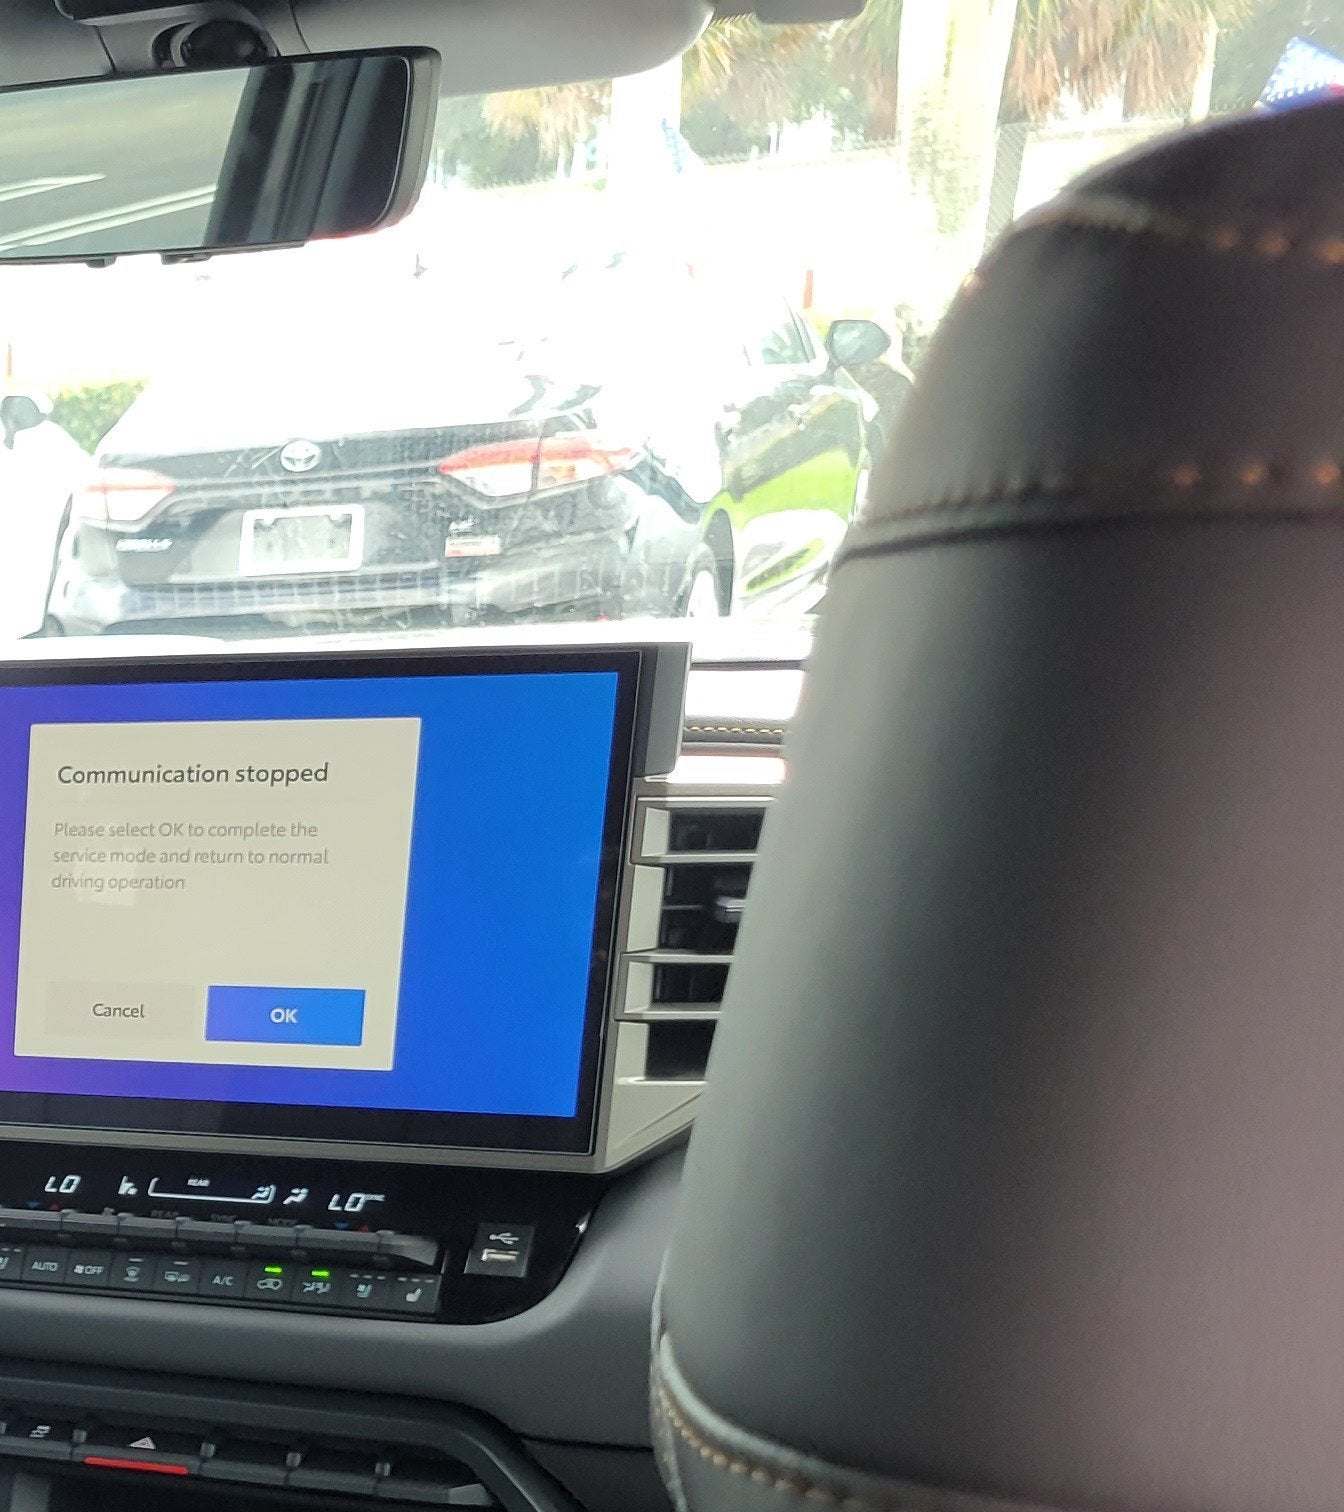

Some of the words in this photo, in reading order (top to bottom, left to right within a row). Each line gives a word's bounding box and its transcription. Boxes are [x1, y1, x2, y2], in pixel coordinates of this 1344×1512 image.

[57, 763, 230, 785] Communication
[235, 762, 329, 787] stopped
[53, 822, 105, 838] Please
[108, 821, 156, 838] select
[158, 822, 184, 838] OK
[187, 823, 203, 838] to
[207, 821, 286, 841] complete
[290, 821, 319, 837] the
[52, 849, 108, 864] service
[110, 848, 156, 863] mode
[158, 848, 190, 863] and
[194, 849, 244, 863] return
[247, 849, 264, 863] to
[268, 848, 329, 864] normal
[51, 873, 105, 892] driving
[108, 874, 186, 892] operation
[92, 1002, 145, 1020] Cancel
[269, 1008, 298, 1024] OK
[31, 1261, 59, 1272] AUTO
[84, 1266, 105, 1276] OFF
[212, 1275, 234, 1286] A/C
